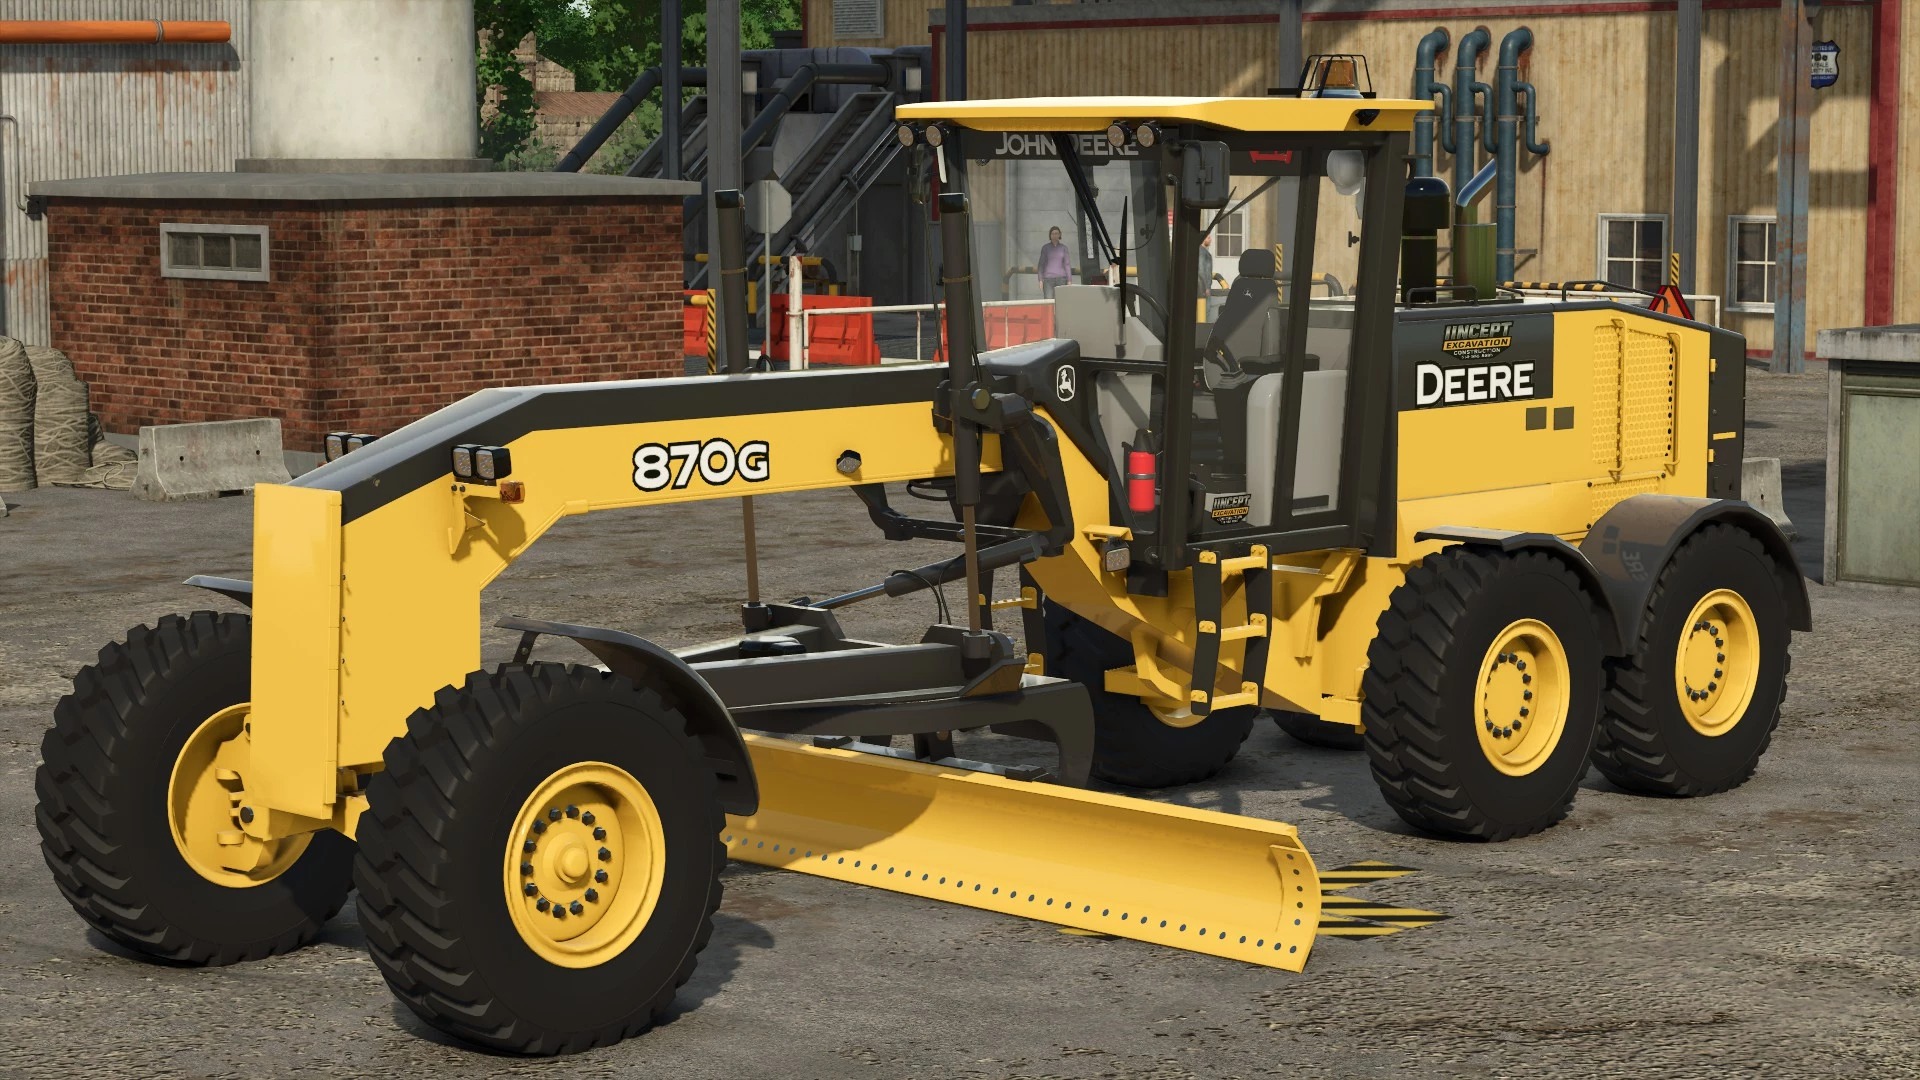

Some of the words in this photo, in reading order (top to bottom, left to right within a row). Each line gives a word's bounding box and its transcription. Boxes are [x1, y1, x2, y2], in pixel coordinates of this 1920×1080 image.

[995, 131, 1057, 156] JOHN
[1446, 339, 1508, 349] EXCAVATION
[1416, 362, 1534, 405] DEERE
[632, 437, 770, 492] 870G
